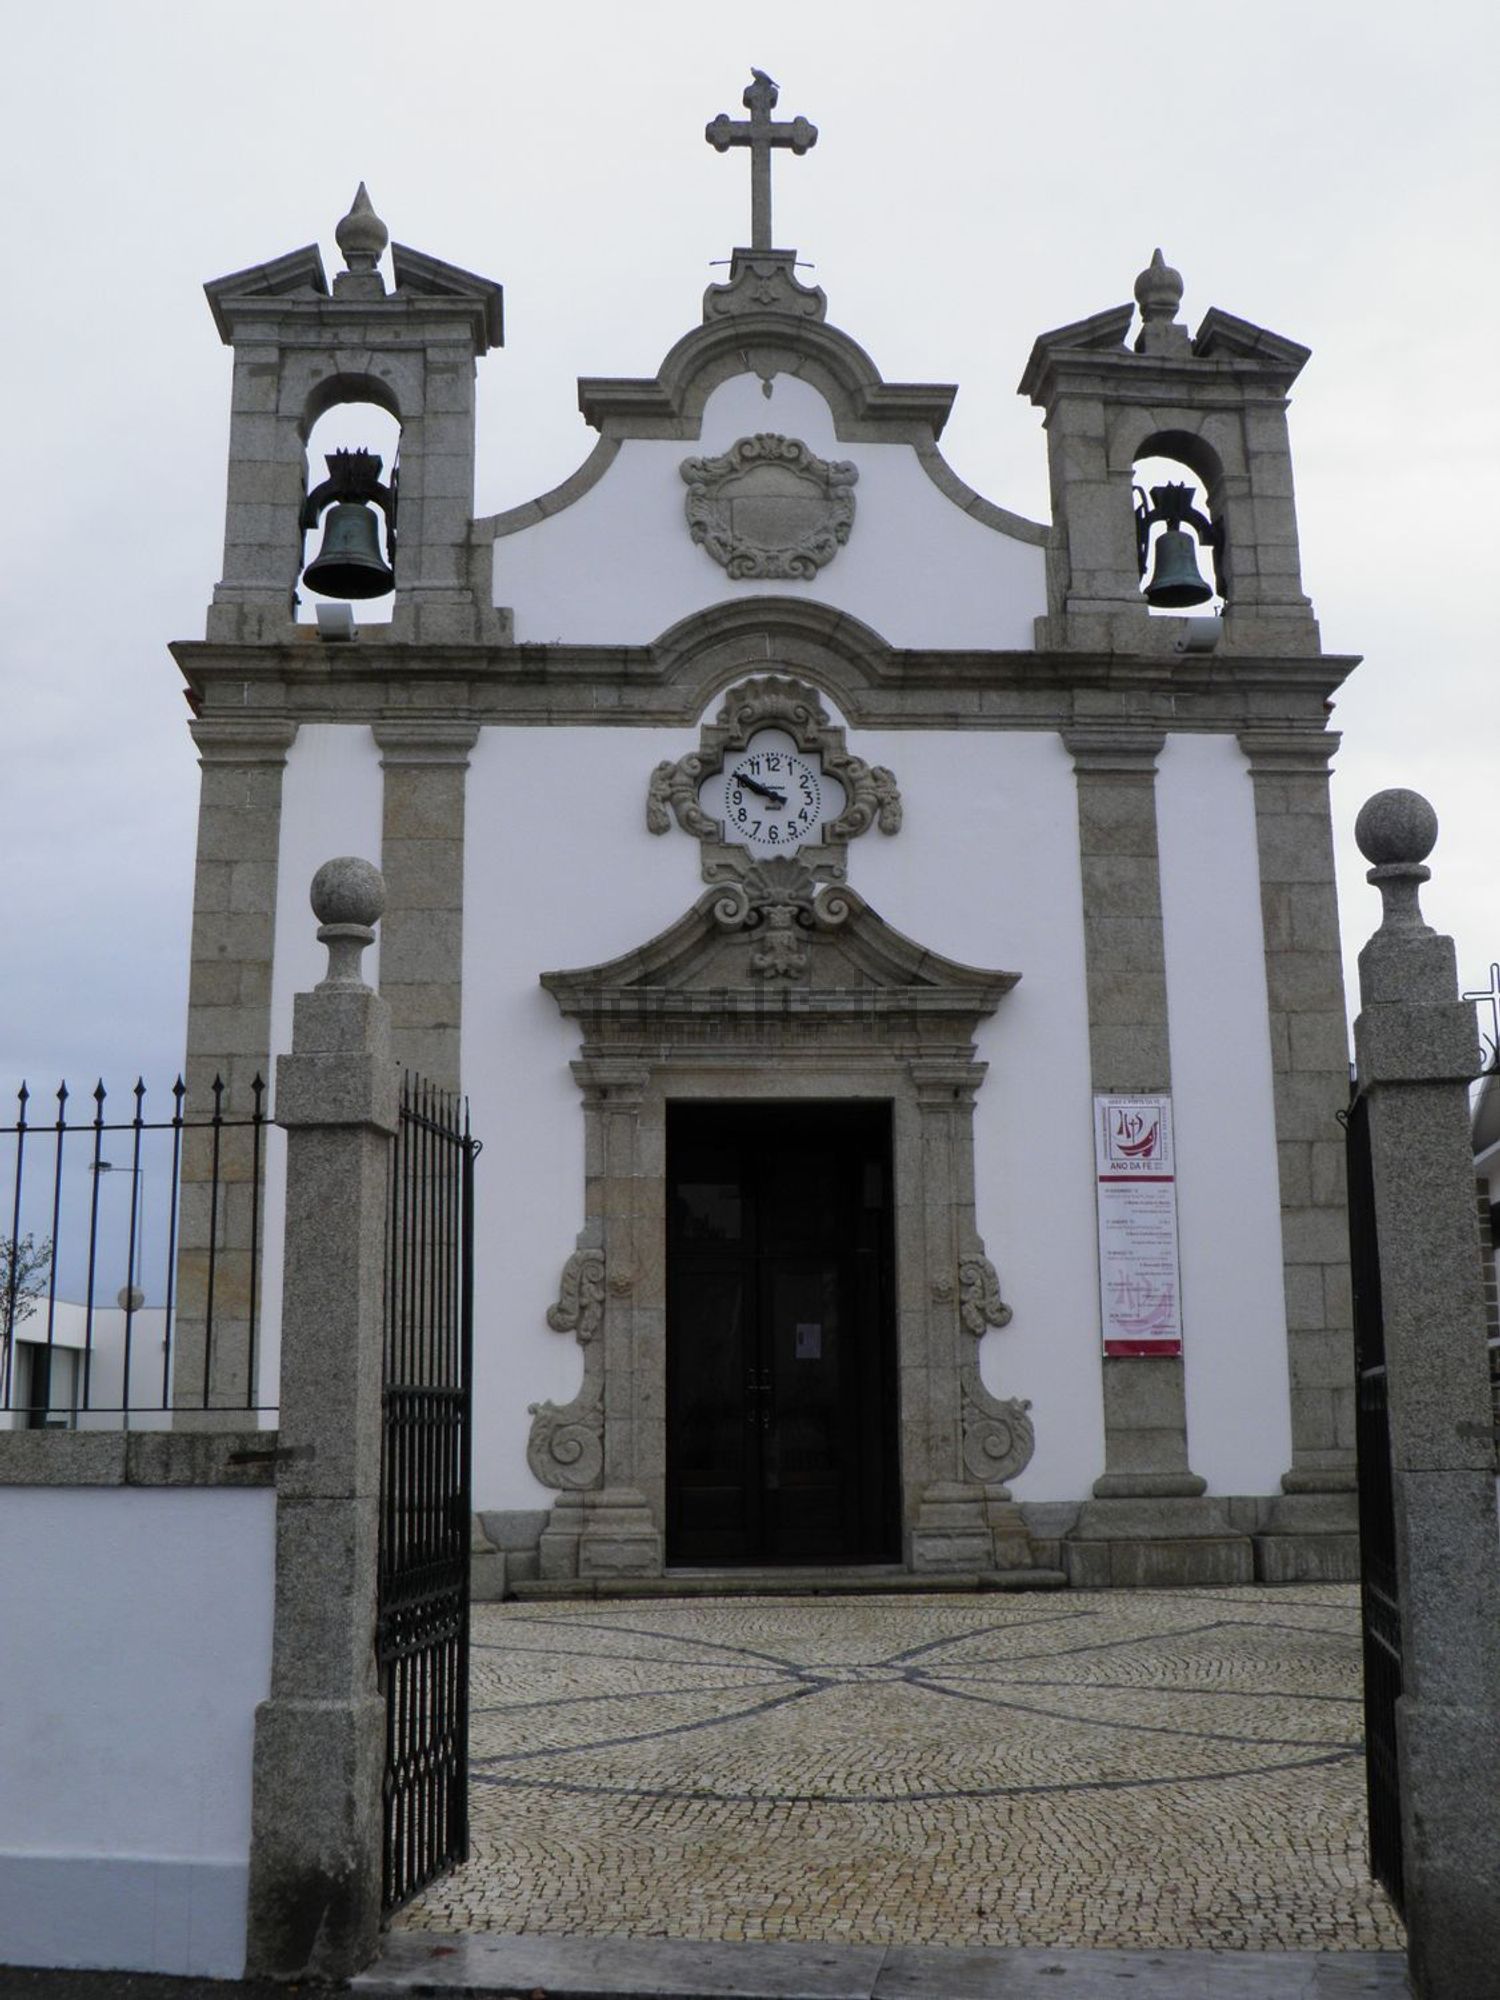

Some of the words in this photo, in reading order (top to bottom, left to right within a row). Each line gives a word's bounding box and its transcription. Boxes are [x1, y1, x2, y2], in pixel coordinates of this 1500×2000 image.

[749, 761, 760, 775] 11
[766, 757, 780, 772] 12
[787, 761, 793, 776] 1
[799, 774, 809, 789] 2
[732, 791, 742, 805] 9
[804, 791, 814, 806] 3
[737, 808, 747, 822] 8
[798, 808, 808, 822] 4
[752, 821, 762, 836] 7
[768, 825, 778, 840] 6
[787, 821, 797, 836] 5
[1110, 1162, 1128, 1170] ANO
[1129, 1162, 1141, 1170] DA
